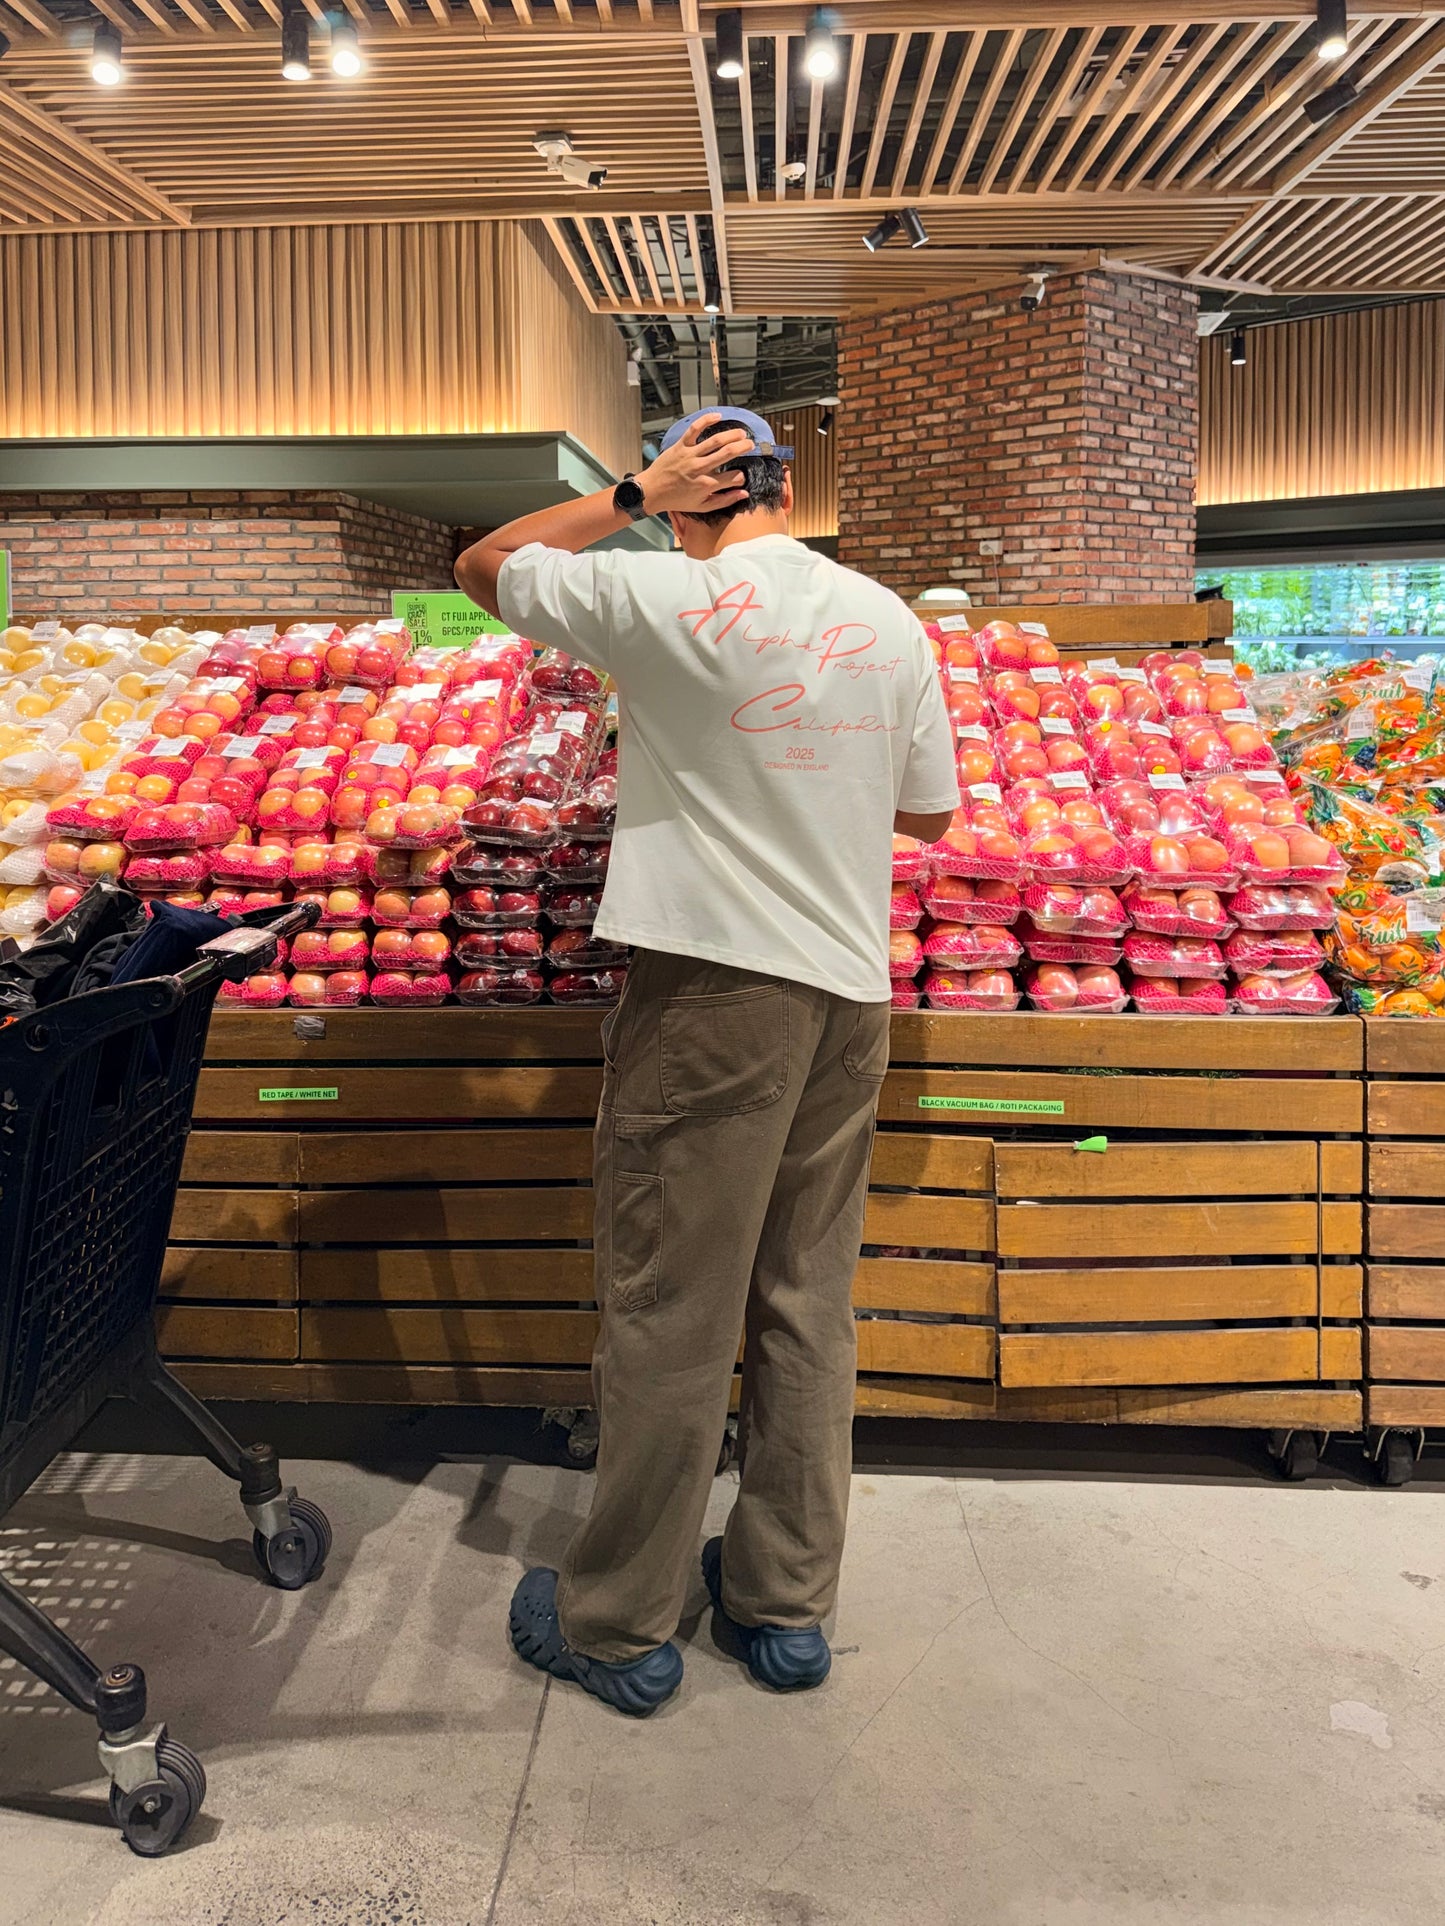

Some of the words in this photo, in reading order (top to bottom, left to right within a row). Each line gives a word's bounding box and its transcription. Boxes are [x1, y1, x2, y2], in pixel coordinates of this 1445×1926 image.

[407, 609, 427, 619] CRAZY
[441, 611, 451, 621] CT
[452, 611, 468, 621] FUJI
[408, 619, 426, 628] SALE
[442, 626, 485, 636] 6PCS/PACK
[678, 581, 823, 654] Alpha
[818, 623, 906, 679] Project
[785, 746, 815, 760] 2025
[803, 763, 830, 771] ENGLAND
[1352, 919, 1406, 944] Fruit
[262, 1091, 276, 1099] RED
[299, 1090, 321, 1098] WHITE
[322, 1090, 337, 1098] NET
[921, 1099, 945, 1107] BLACK
[946, 1100, 978, 1108] VACUUM
[979, 1101, 994, 1109] BAG
[1000, 1102, 1018, 1110] ROTI
[1018, 1103, 1062, 1112] PACKAGING
